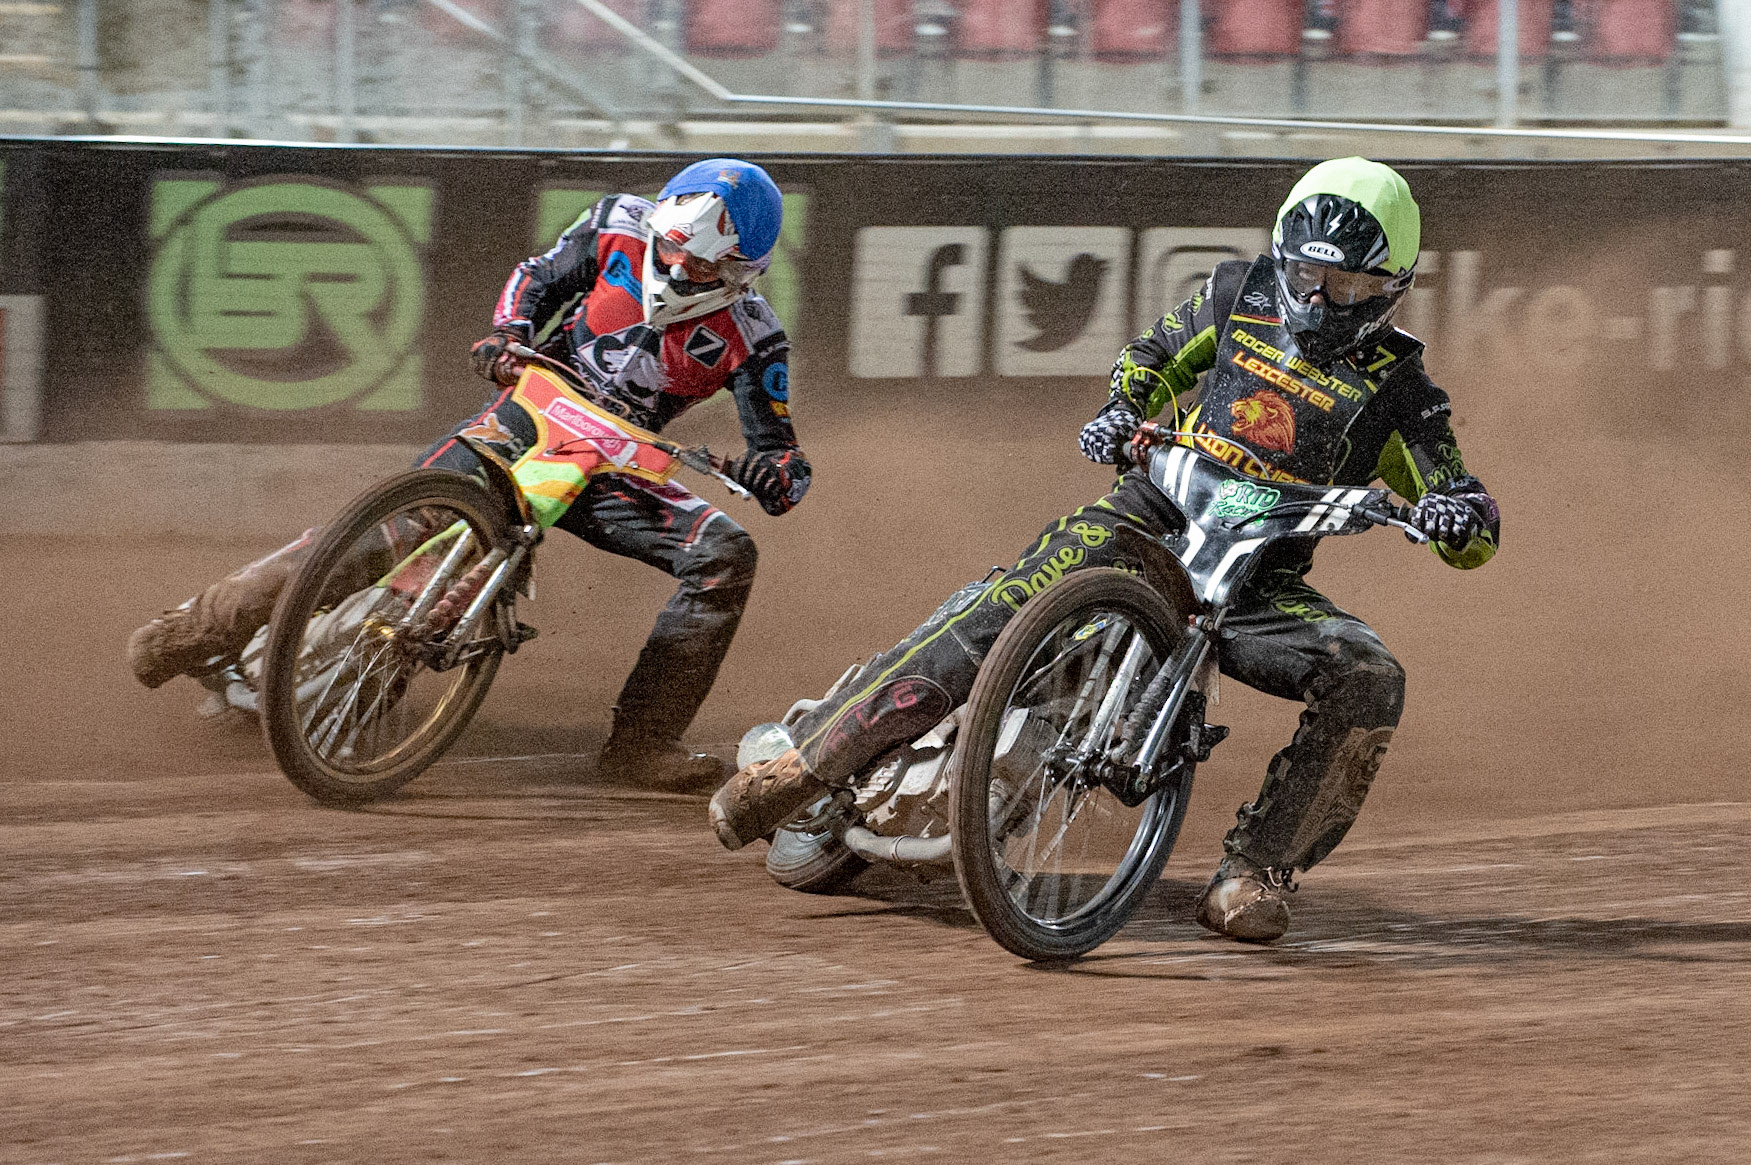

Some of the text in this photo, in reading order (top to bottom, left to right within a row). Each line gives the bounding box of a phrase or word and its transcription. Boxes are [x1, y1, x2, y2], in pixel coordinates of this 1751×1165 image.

[1307, 246, 1337, 258] BELL
[1231, 328, 1285, 363] ROGER
[1284, 355, 1363, 402] WEBSTER
[1232, 350, 1336, 413] LEICESTER
[1194, 422, 1312, 485] LION CUB
[991, 547, 1085, 612] Dave
